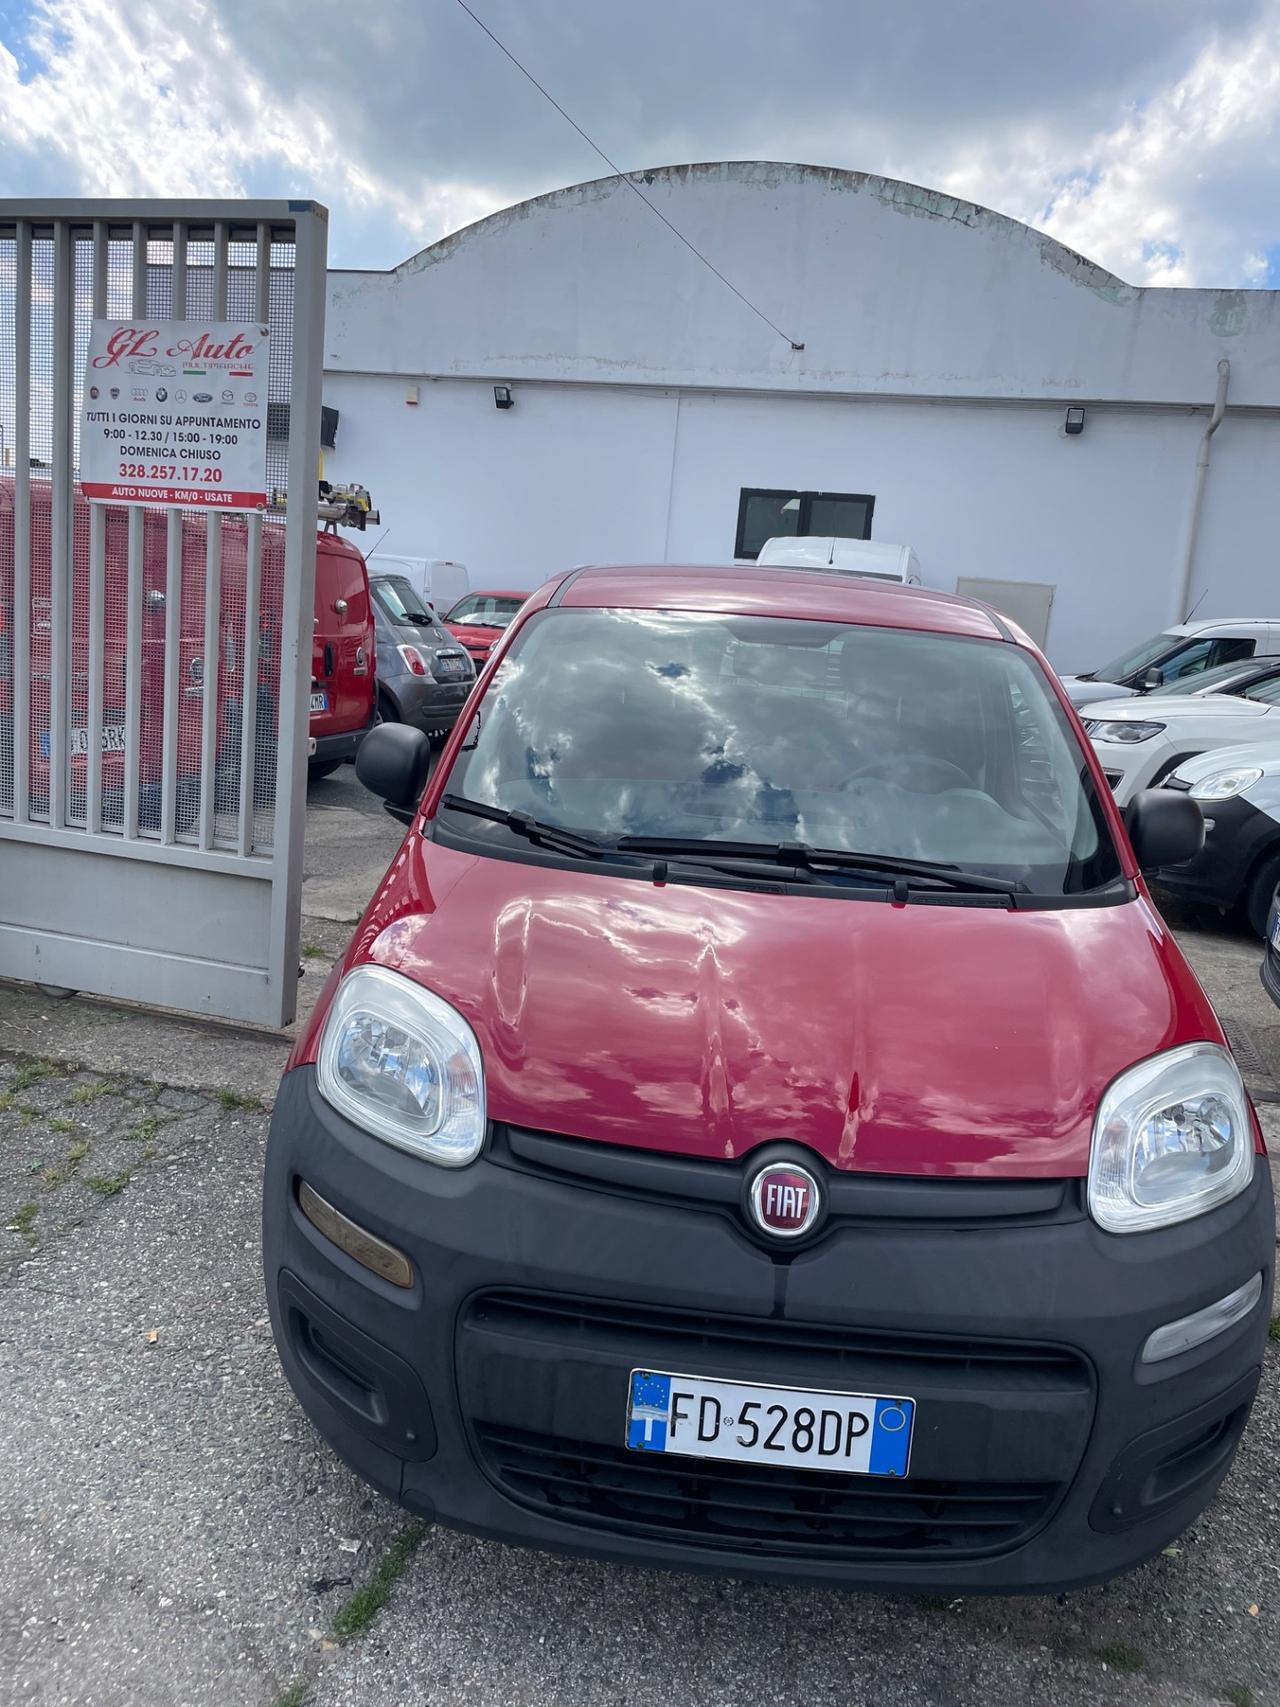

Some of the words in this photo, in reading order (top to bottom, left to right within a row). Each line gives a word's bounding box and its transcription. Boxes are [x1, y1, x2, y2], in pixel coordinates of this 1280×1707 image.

[166, 333, 254, 361] Auto
[86, 412, 110, 422] TUTTI
[112, 413, 116, 422] I
[119, 413, 158, 425] GIORNI
[160, 415, 173, 426] SU
[175, 416, 261, 430] APPUNTAMENTO
[103, 429, 126, 439] 9:00
[135, 431, 162, 442] 12.30
[173, 432, 200, 443] 15:00
[210, 434, 238, 445] 19:00
[120, 446, 177, 459] DOMENICA
[179, 449, 221, 460] CHIUSO
[119, 463, 222, 483] 328.257.17.20
[112, 487, 136, 497] AUTO
[138, 488, 168, 499] NUOVE
[204, 492, 233, 503] USATE
[766, 1184, 807, 1219] FIAT
[736, 1401, 870, 1457] 528DP
